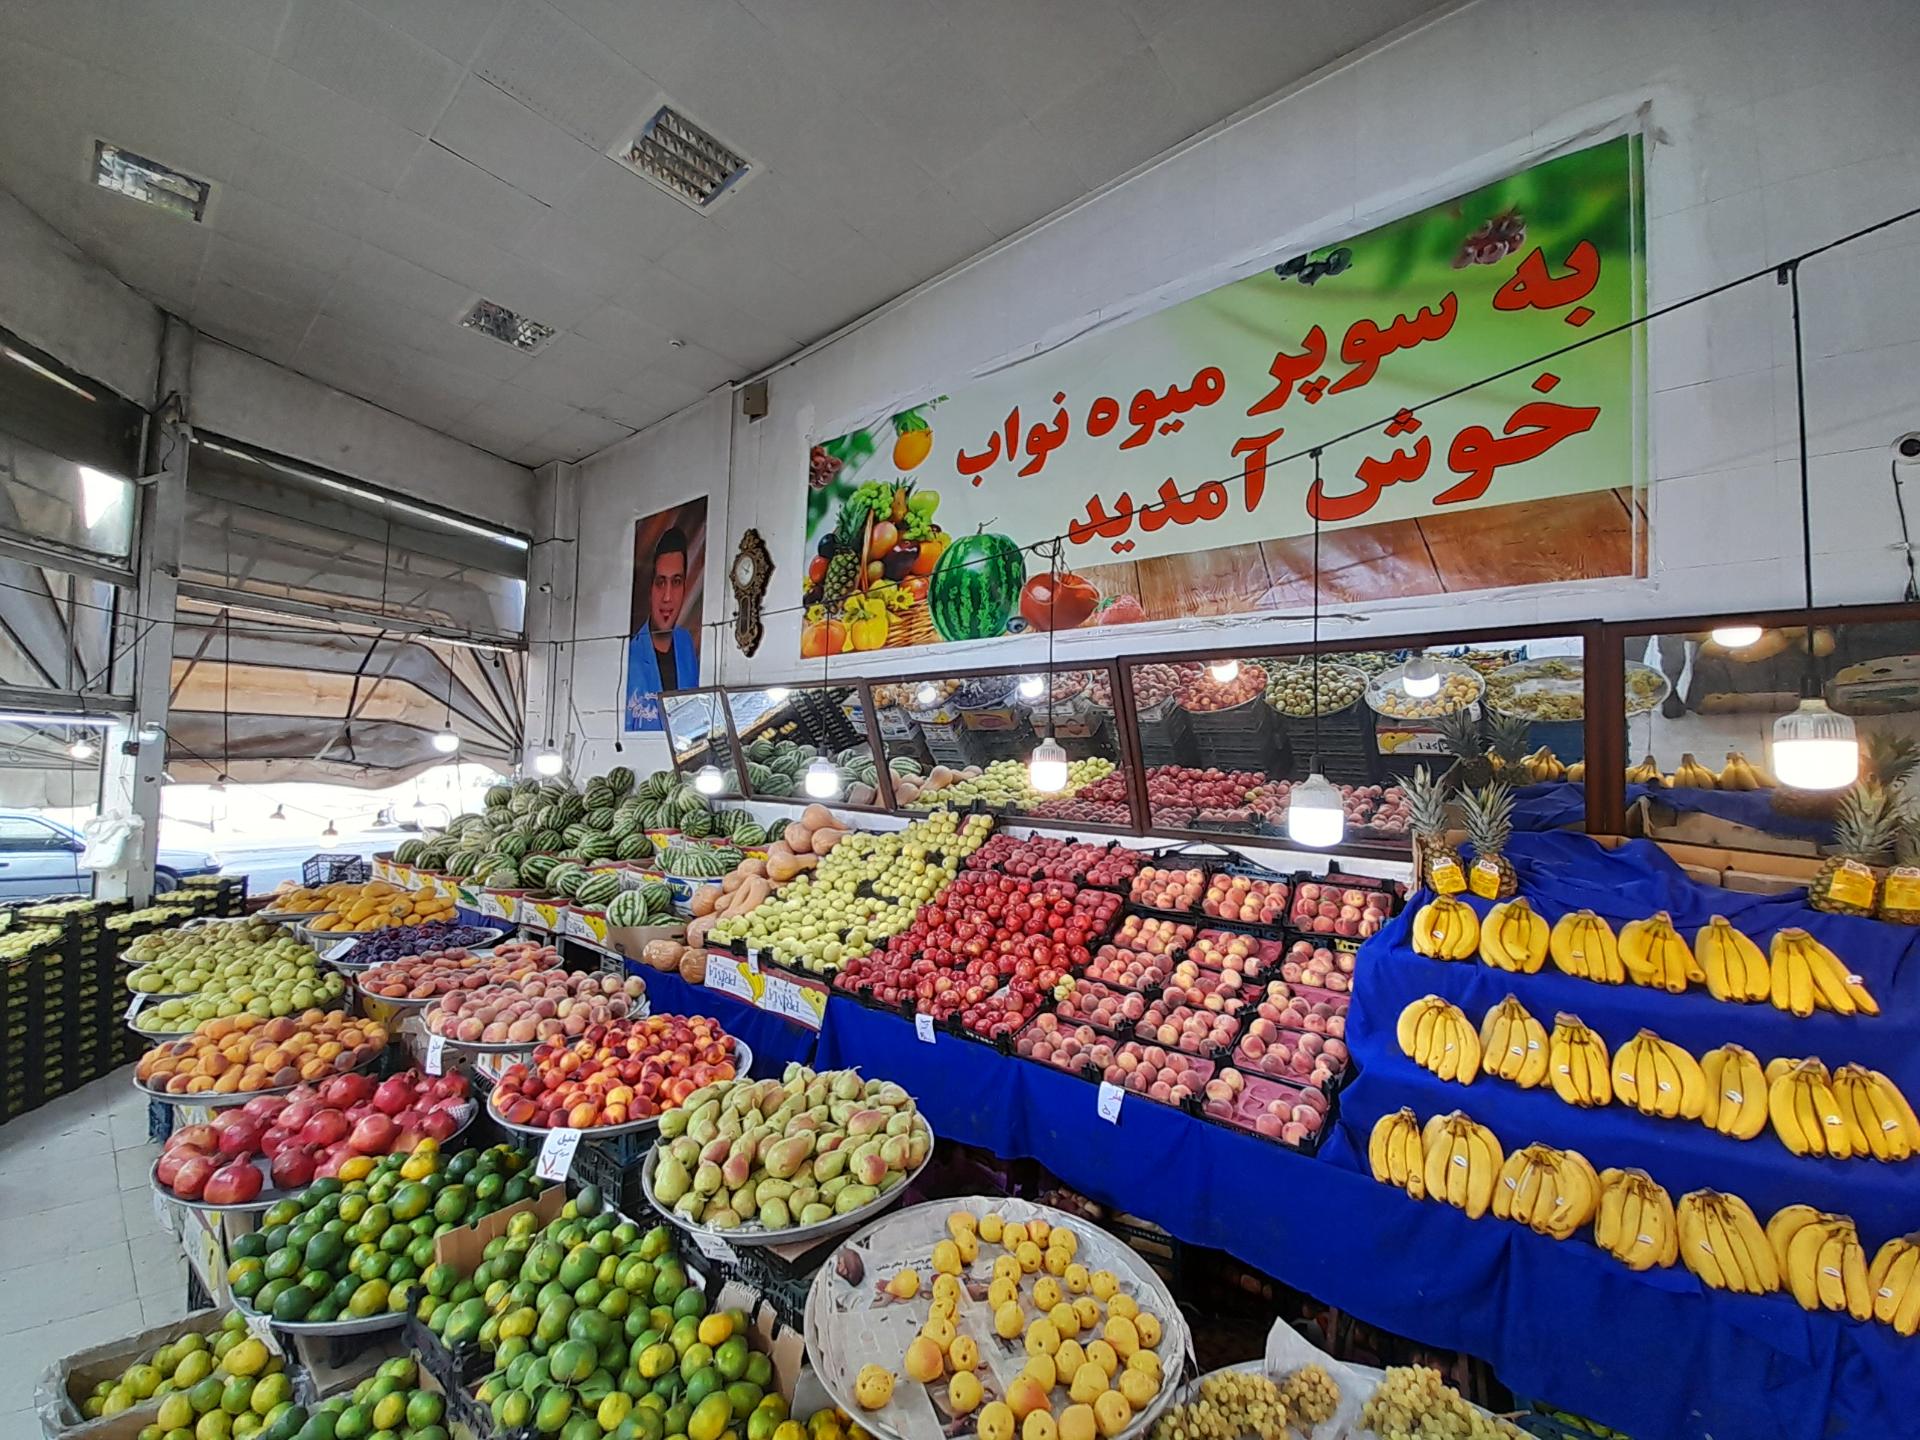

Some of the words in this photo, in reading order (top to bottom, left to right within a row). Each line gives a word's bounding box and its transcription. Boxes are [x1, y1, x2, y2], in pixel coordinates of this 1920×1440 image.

[1493, 239, 1600, 327] به
[1086, 366, 1227, 450] میوه
[1247, 292, 1459, 416] سوپر
[956, 391, 1070, 487] نواب
[1069, 428, 1285, 553] آمدید
[1306, 372, 1601, 521] خوش
